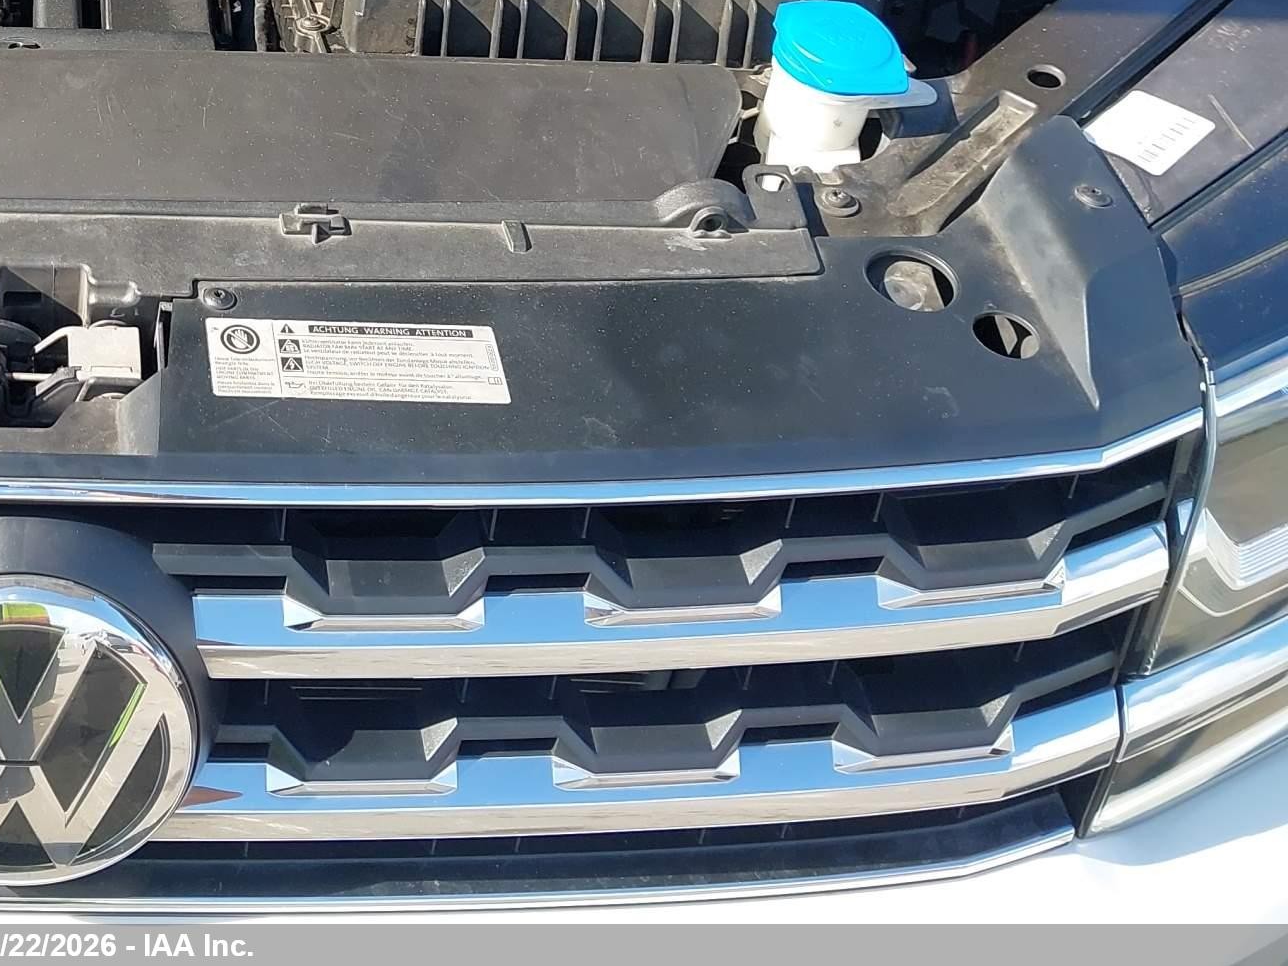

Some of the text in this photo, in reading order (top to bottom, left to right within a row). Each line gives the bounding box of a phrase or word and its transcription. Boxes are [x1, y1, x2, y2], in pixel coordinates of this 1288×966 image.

[312, 325, 466, 337] ACHTUNG WARNING ATTENTION
